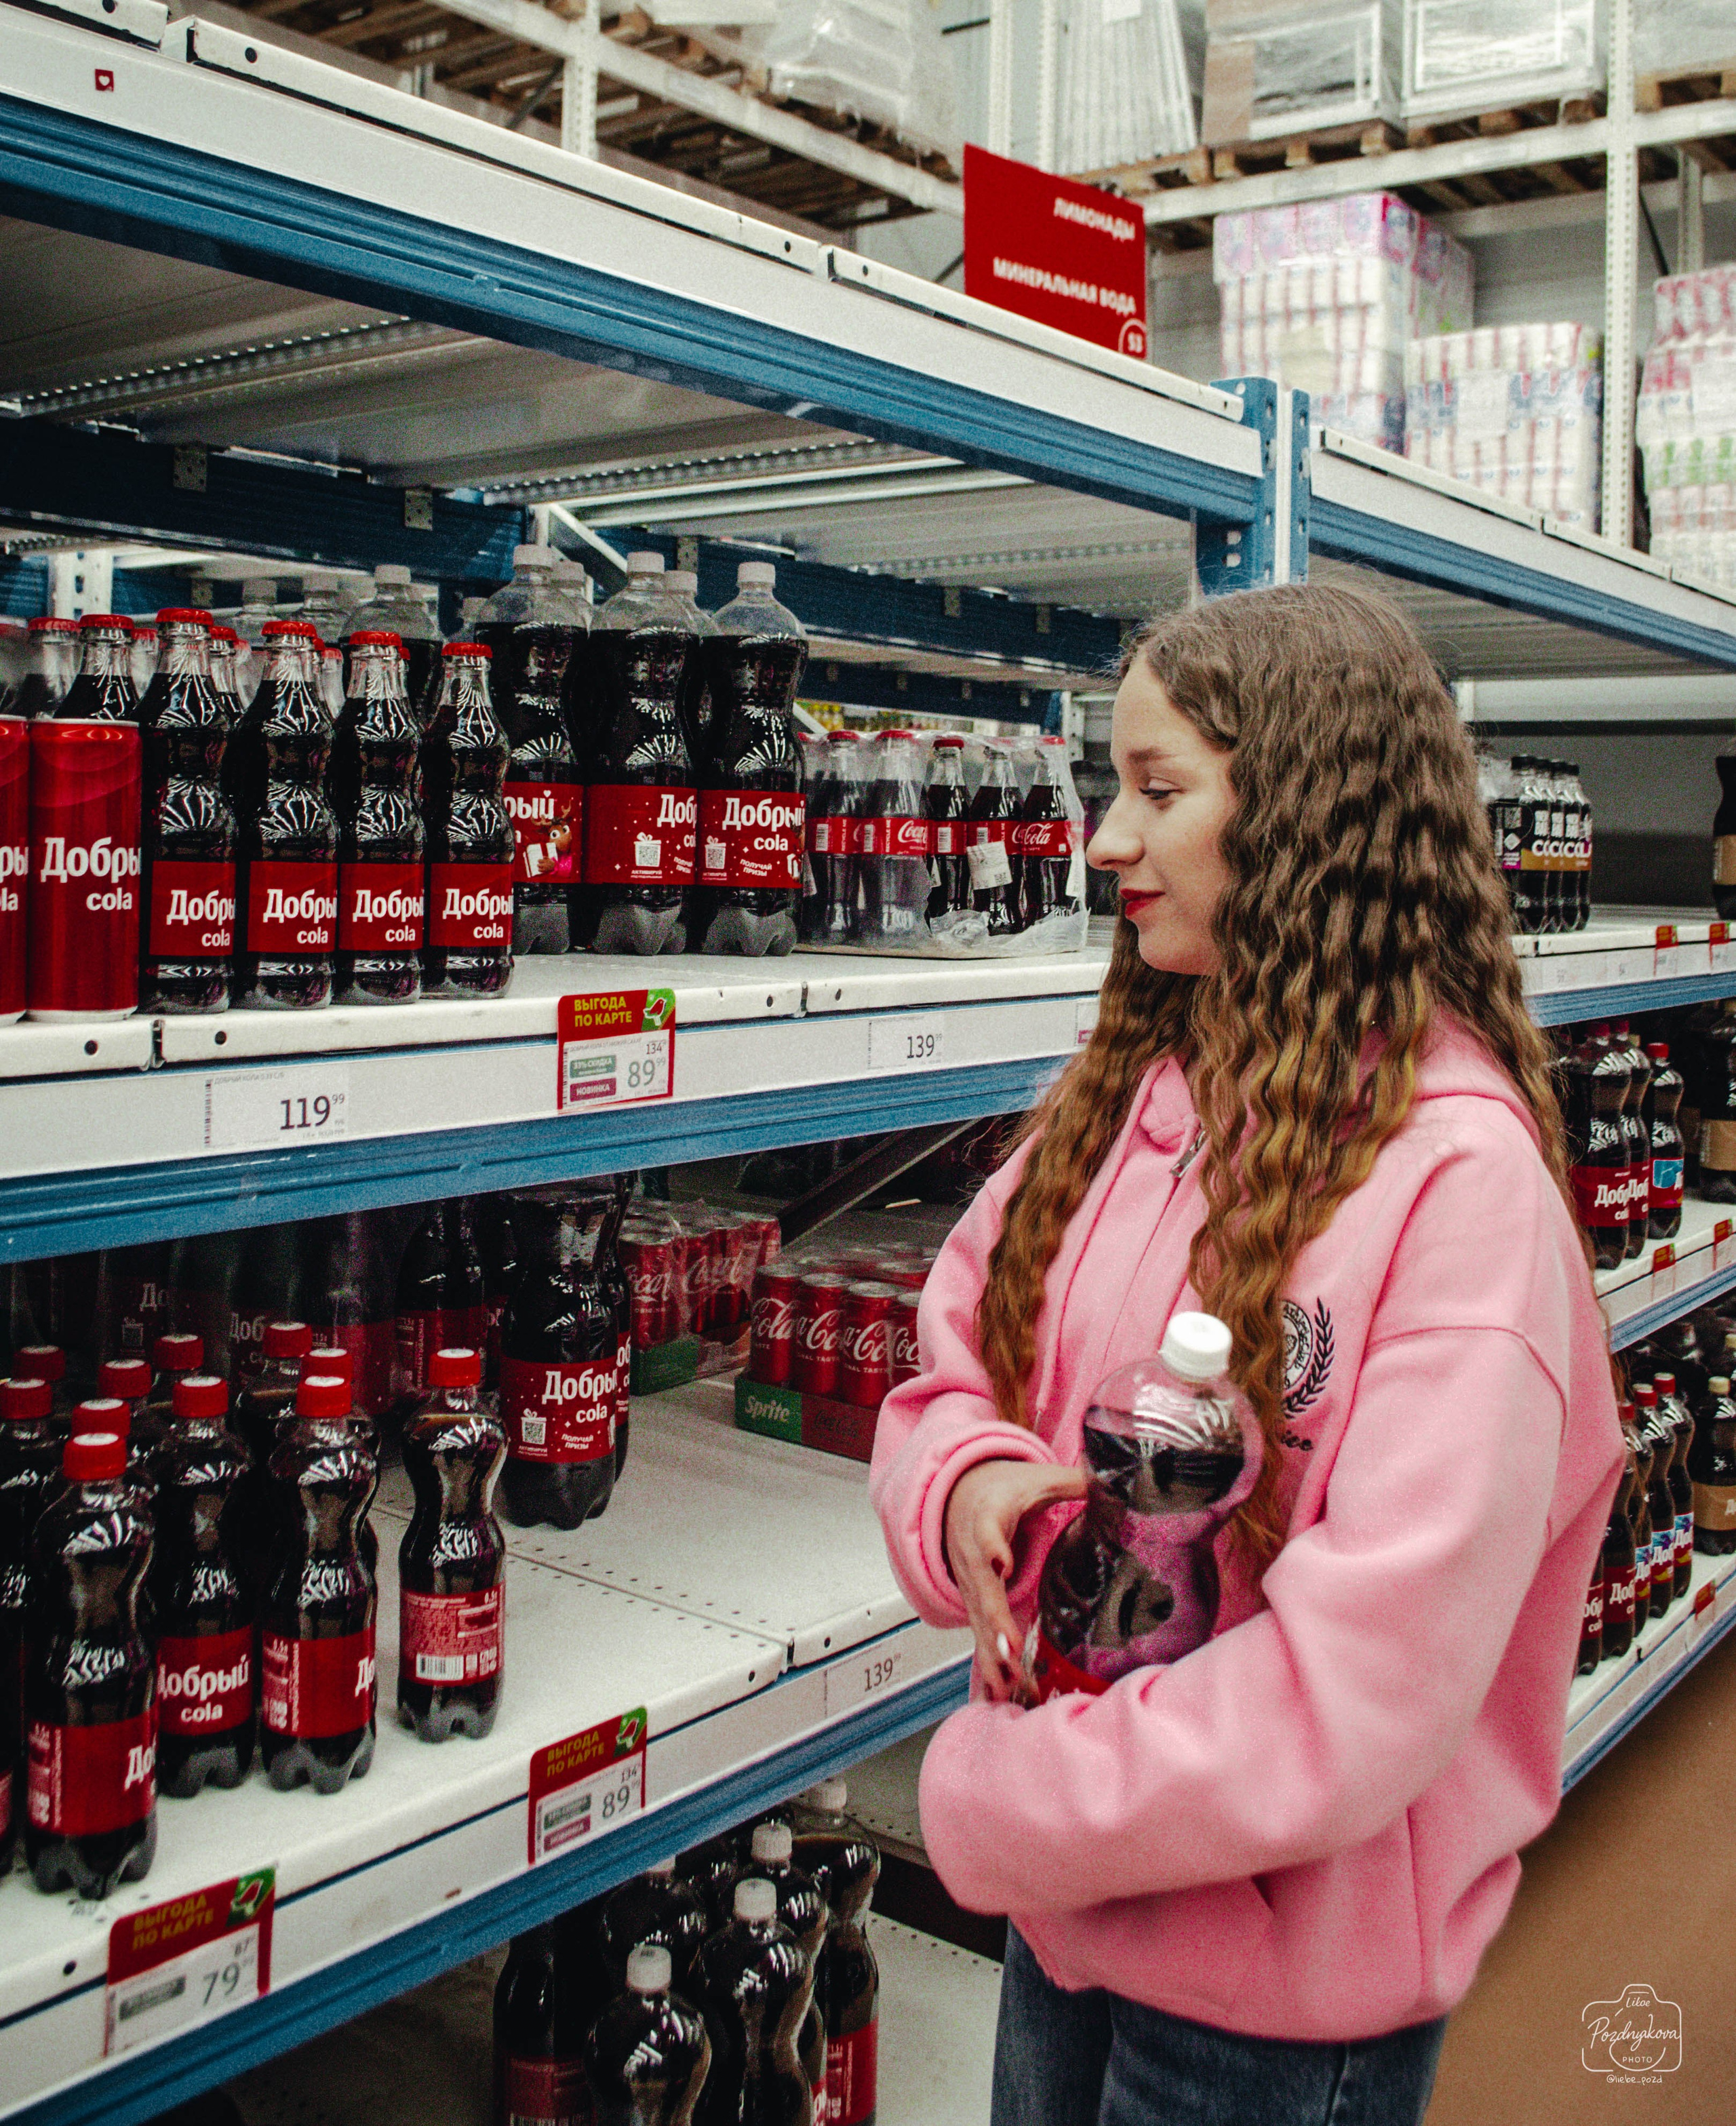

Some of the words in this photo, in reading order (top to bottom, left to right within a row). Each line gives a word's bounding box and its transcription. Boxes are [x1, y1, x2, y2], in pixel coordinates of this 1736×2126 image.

[1053, 196, 1136, 243] ЛИМОНАДЫ
[992, 256, 1098, 304] МИНЕРАЛЬНАЯ
[1099, 286, 1137, 317] ВОДА
[753, 834, 789, 851] cola
[40, 836, 142, 884] Добры
[740, 859, 772, 871] ПОЛУЧАЙ
[743, 867, 768, 877] ПРИЗЫ
[86, 887, 133, 911] cola
[166, 889, 236, 926] Добры
[262, 888, 338, 924] Добры
[201, 928, 231, 947] cola
[297, 926, 328, 944] cola
[385, 925, 416, 943] cola
[473, 922, 504, 939] cola
[574, 996, 627, 1012] ВЫГОДА
[574, 1015, 593, 1027] ПО
[595, 1010, 632, 1025] КАРТЕ
[906, 1034, 935, 1059] 139
[627, 1059, 656, 1088] 89
[576, 1084, 610, 1096] НОВИНКА
[280, 1095, 331, 1130] 119
[332, 1093, 345, 1105] 99
[576, 1402, 608, 1423] cola
[746, 1394, 791, 1423] Sprite
[865, 1657, 893, 1692] 139
[180, 1701, 222, 1723] cola
[547, 1730, 599, 1763] ВЫГОДА
[547, 1760, 565, 1777] ПО
[567, 1742, 605, 1769] КАРТЕ
[602, 1785, 629, 1819] 89
[134, 1892, 207, 1933] ВЫГОДА
[132, 1929, 158, 1950] ПО
[161, 1908, 214, 1940] КАРТЕ
[204, 1962, 241, 2006] 79
